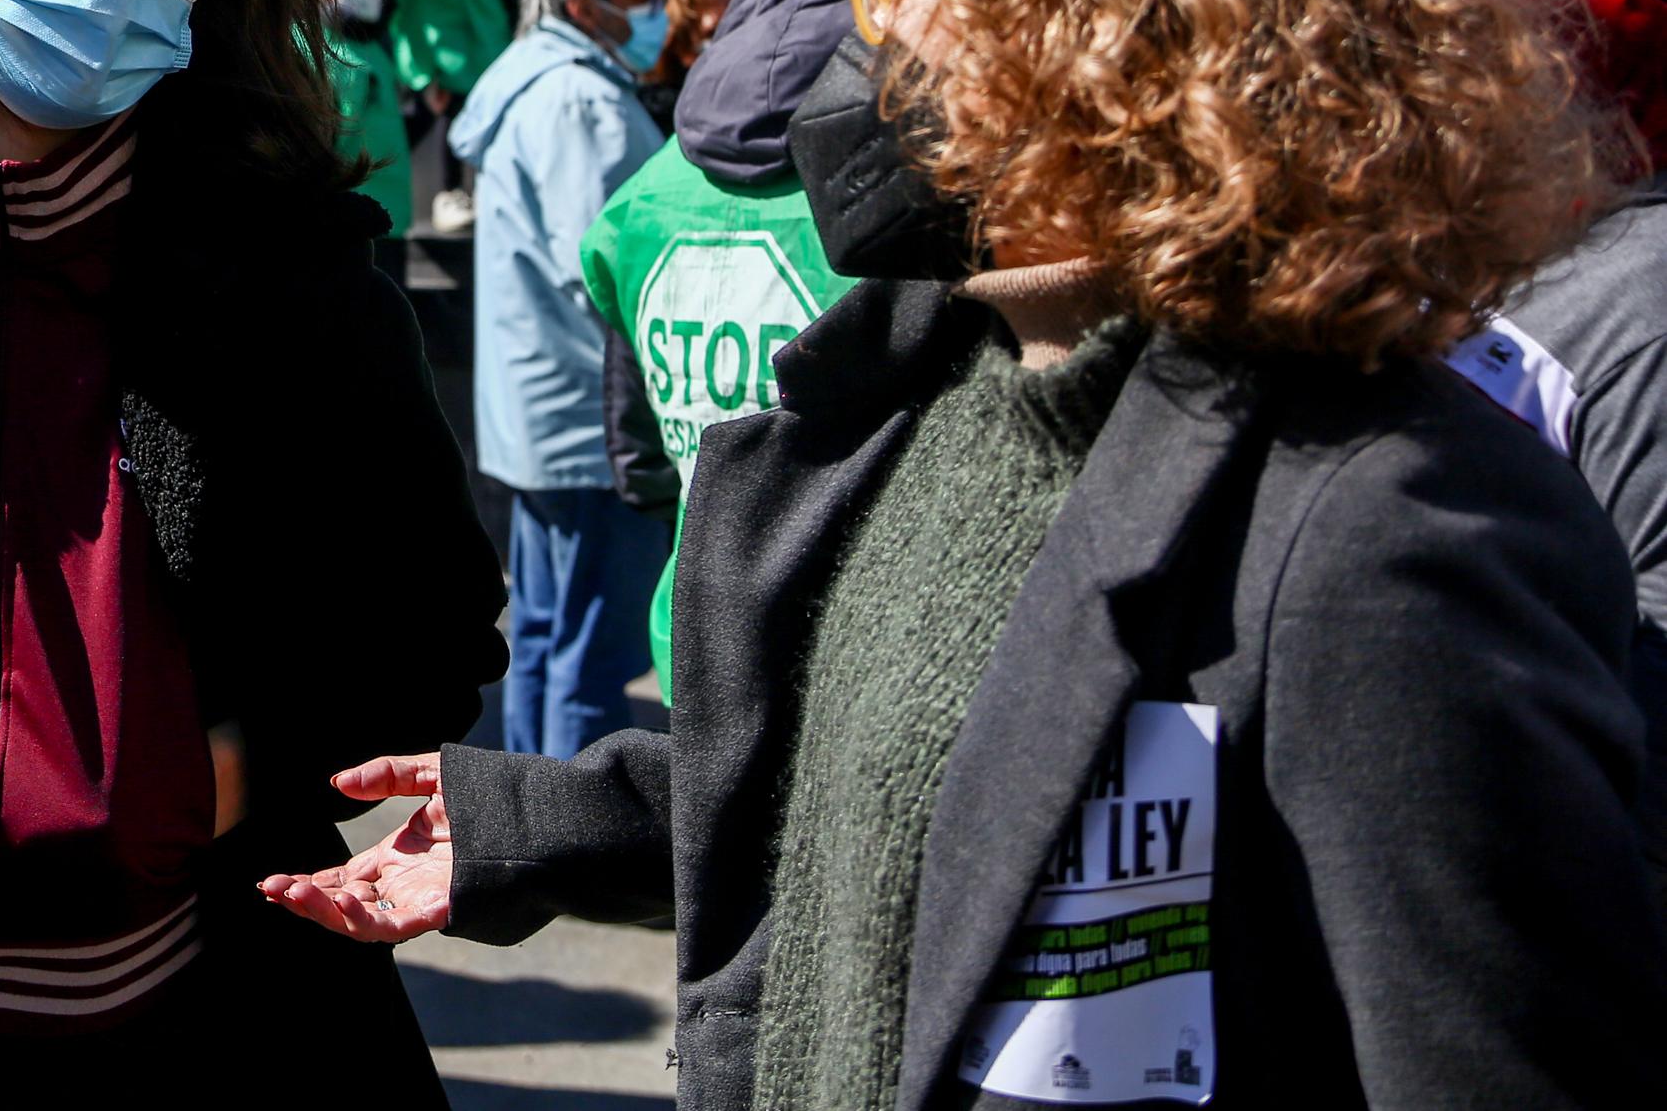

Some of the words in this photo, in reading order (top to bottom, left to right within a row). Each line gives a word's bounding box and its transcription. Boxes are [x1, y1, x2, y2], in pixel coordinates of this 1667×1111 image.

[1107, 797, 1192, 882] LEY
[1036, 951, 1073, 976] digna
[1074, 947, 1109, 975] para
[1109, 937, 1148, 963] todas
